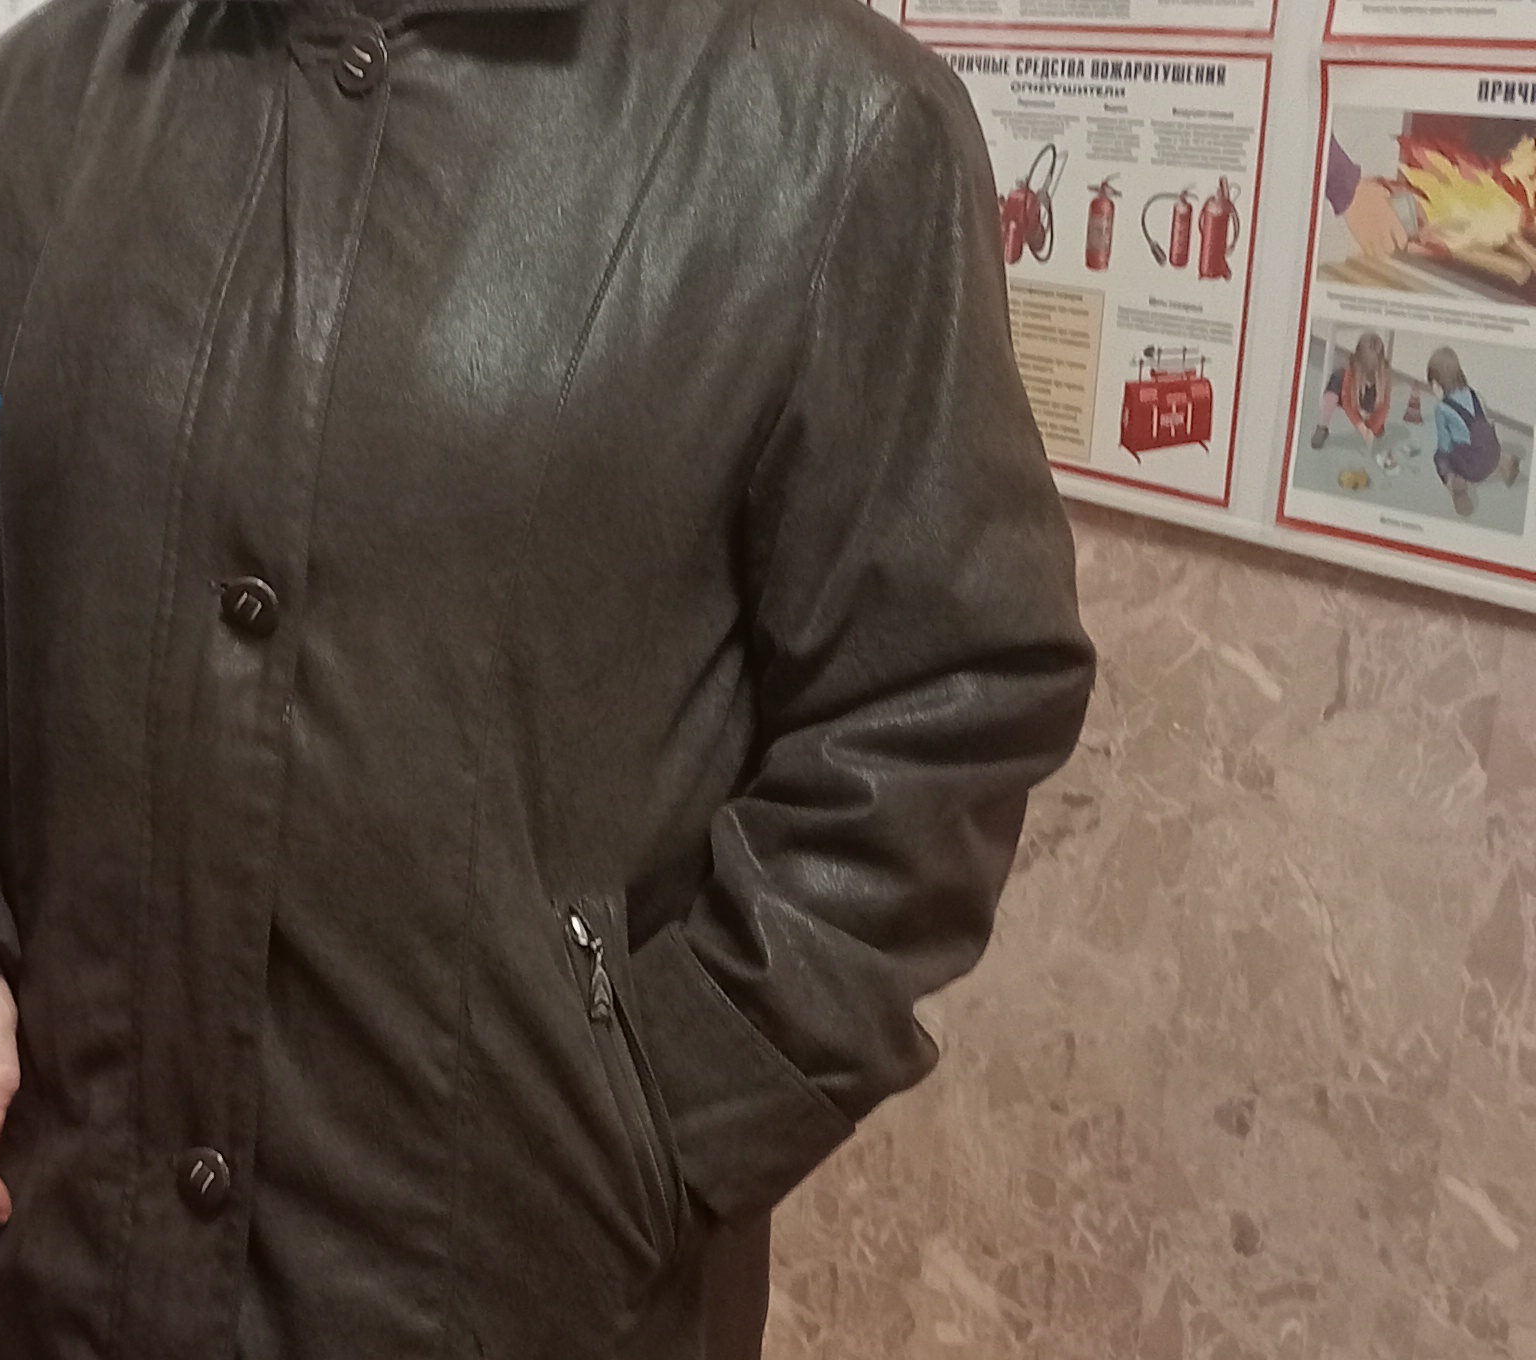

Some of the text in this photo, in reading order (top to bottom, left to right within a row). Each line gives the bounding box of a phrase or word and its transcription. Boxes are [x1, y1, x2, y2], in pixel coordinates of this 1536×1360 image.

[942, 53, 1226, 86] РВИЧНЫЕ СРЕДСТВА ПОЖАРОТУШЕНИЯ
[1010, 80, 1125, 99] ОГНЕТУШИТЕЛИ
